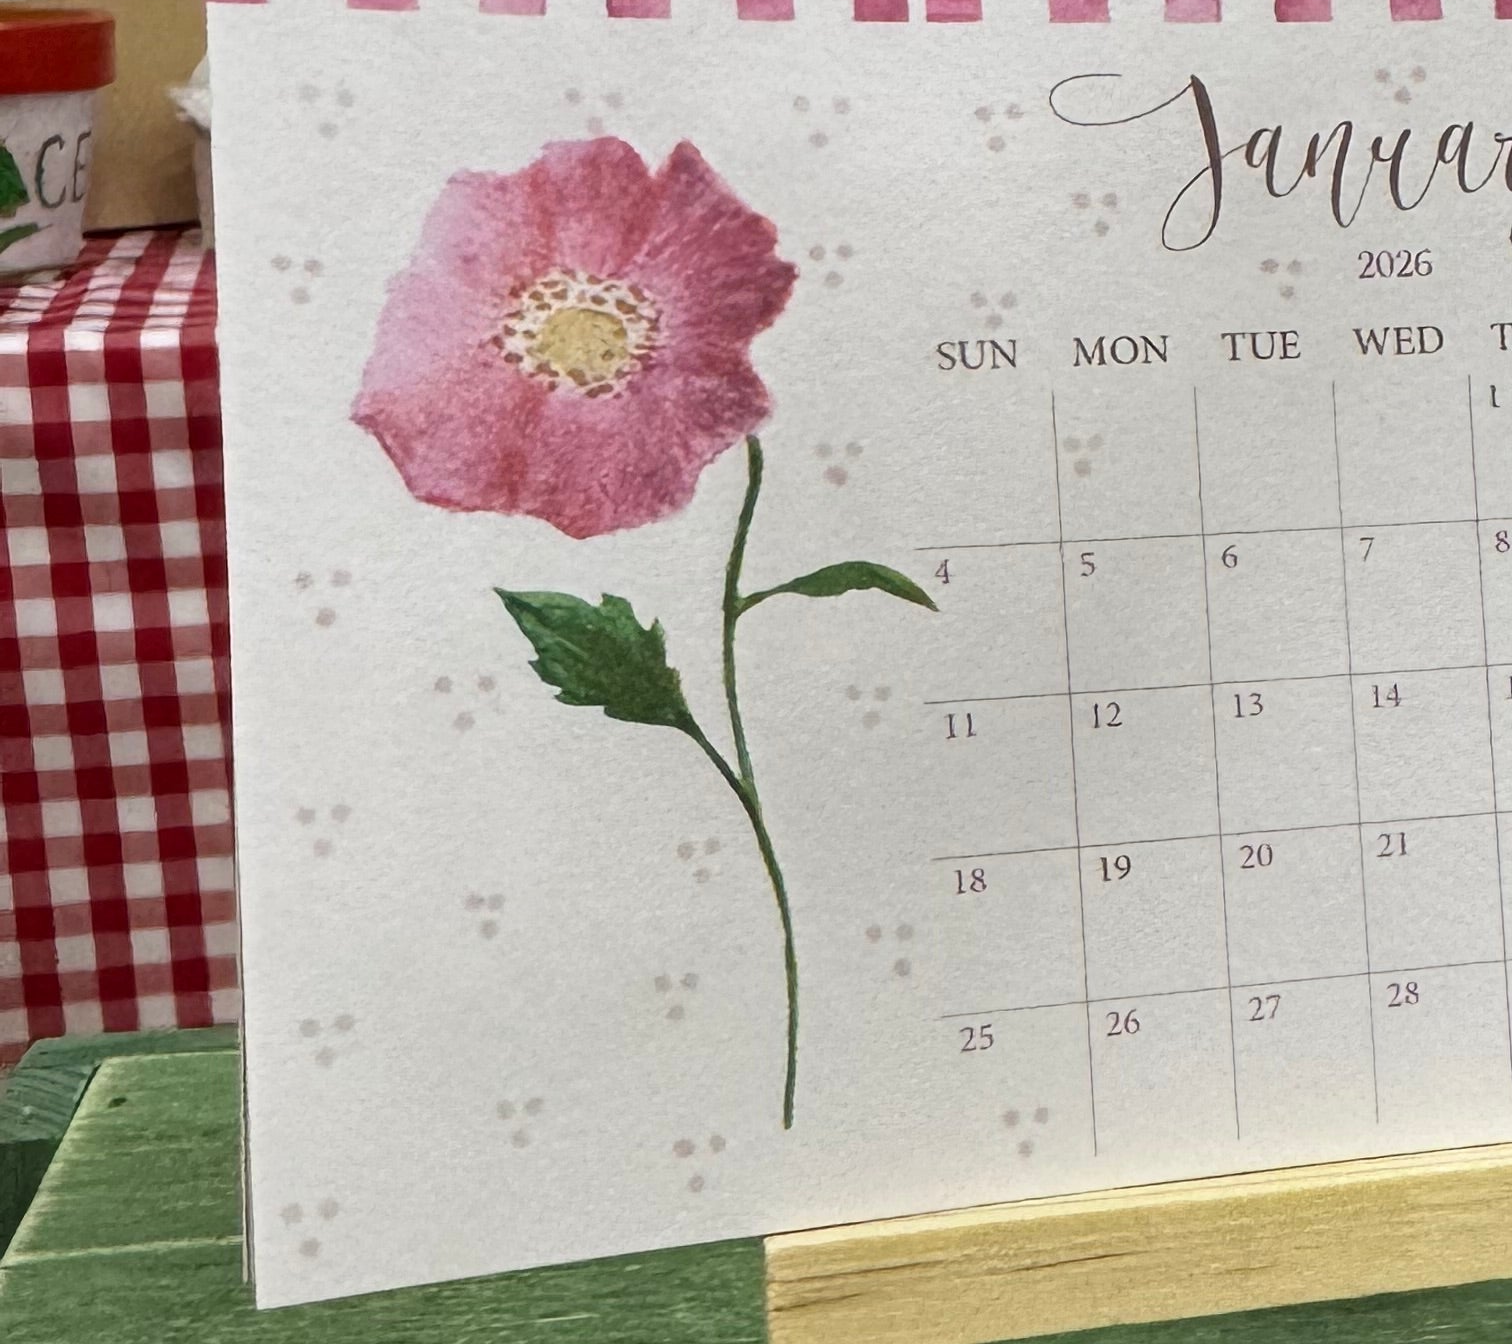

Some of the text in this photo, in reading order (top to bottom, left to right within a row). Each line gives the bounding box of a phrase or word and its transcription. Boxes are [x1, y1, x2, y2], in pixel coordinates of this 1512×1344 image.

[1357, 247, 1433, 280] 2026
[935, 338, 1017, 371] SUN
[1072, 334, 1170, 368] MON
[1220, 329, 1302, 362] TUE
[1351, 325, 1444, 357] WED
[1489, 384, 1501, 409] 1
[934, 558, 951, 585] 4
[1080, 551, 1097, 578] 5
[1220, 544, 1239, 569] 6
[1359, 536, 1376, 563] 7
[1494, 529, 1511, 554] 8
[943, 712, 977, 741] 11
[1093, 701, 1123, 729] 12
[1233, 692, 1264, 719] 13
[1371, 682, 1403, 709] 14
[953, 867, 988, 895] 18
[1099, 854, 1132, 883] 19
[1239, 843, 1274, 870] 20
[1376, 831, 1408, 858] 21
[958, 1023, 995, 1054] 25
[1105, 1008, 1141, 1038] 26
[1248, 993, 1282, 1022] 27
[1386, 981, 1420, 1009] 28
